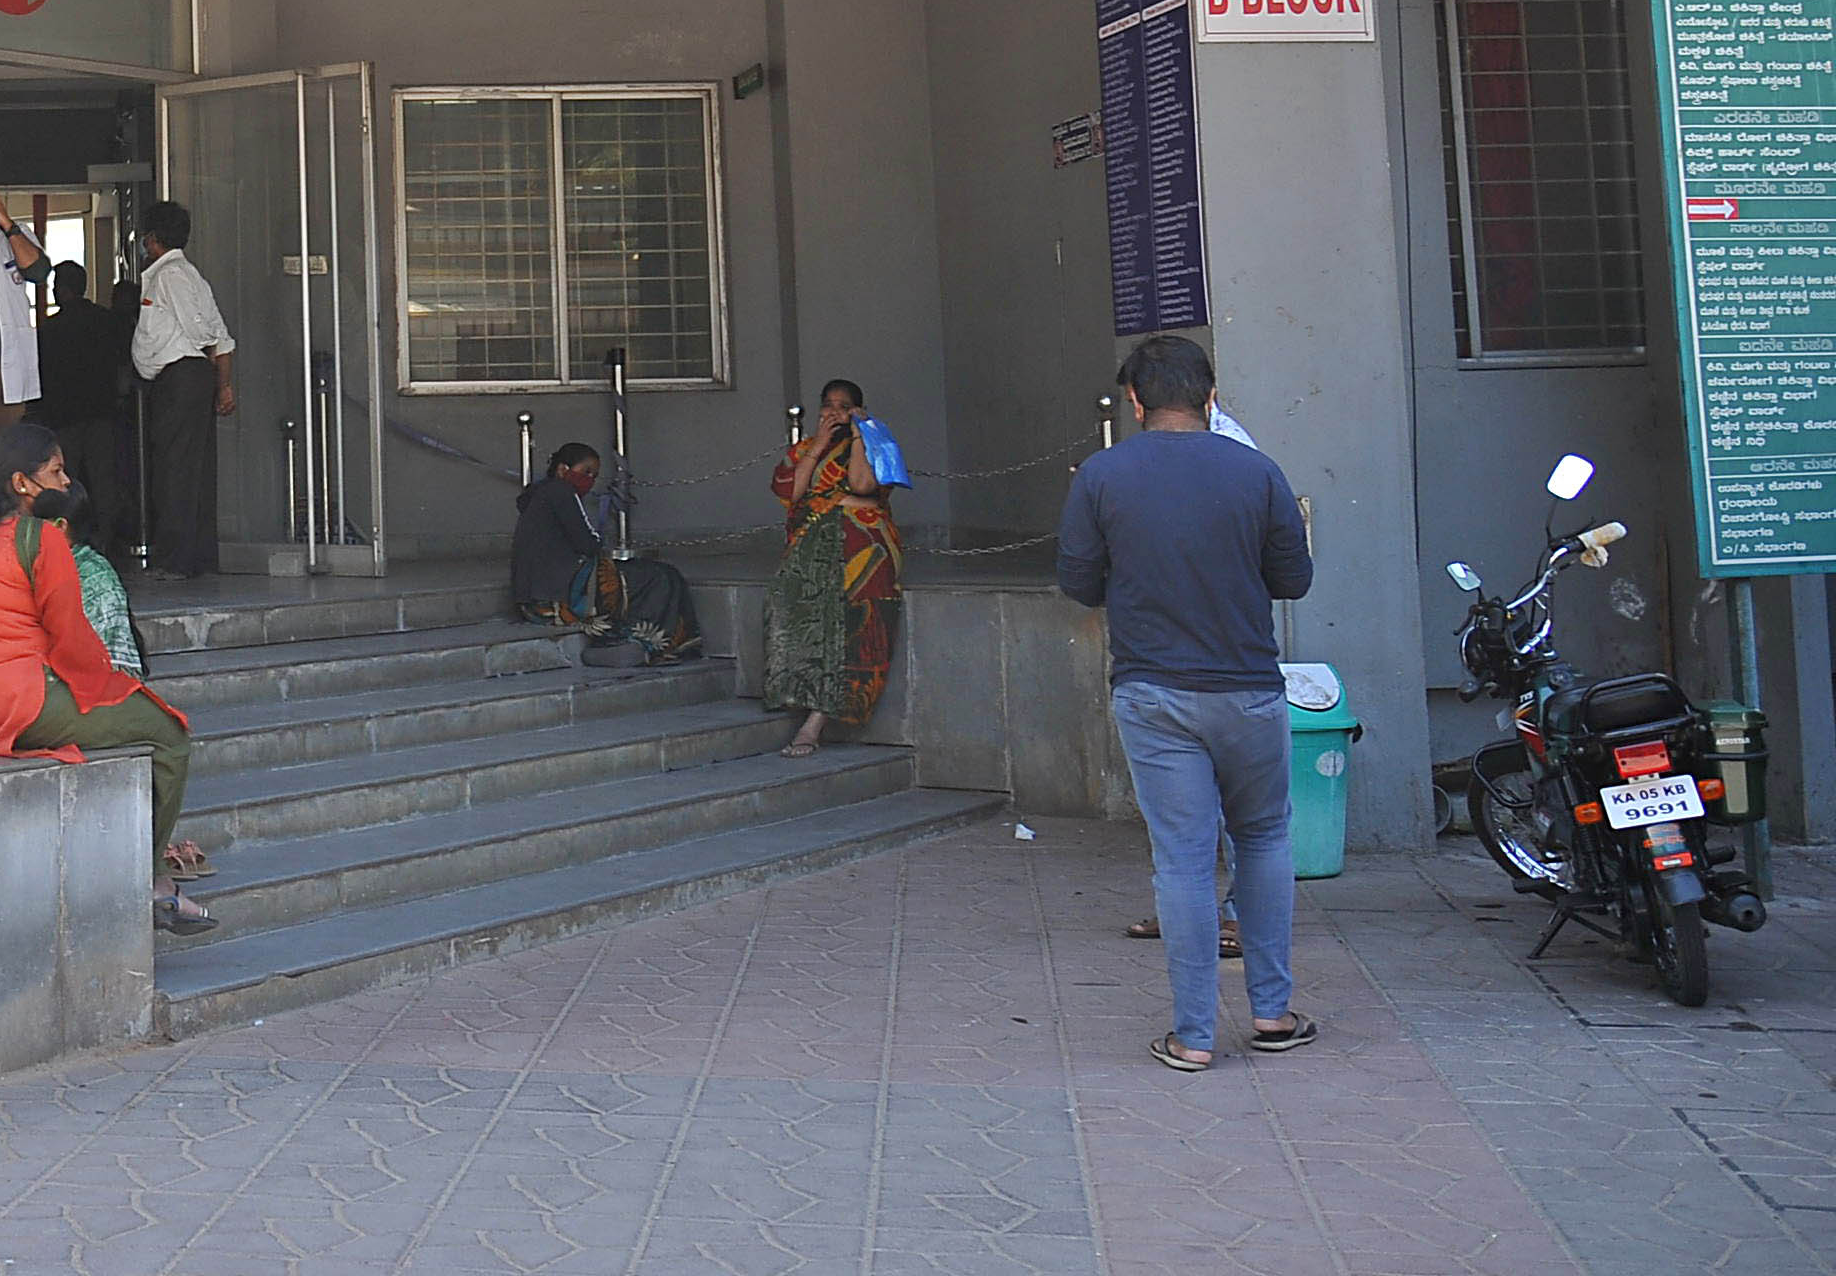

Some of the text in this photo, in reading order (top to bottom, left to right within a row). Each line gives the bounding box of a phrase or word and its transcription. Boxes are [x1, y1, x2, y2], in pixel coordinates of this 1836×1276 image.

[1611, 784, 1686, 804] KA 05 KB
[1625, 800, 1688, 820] 9691
